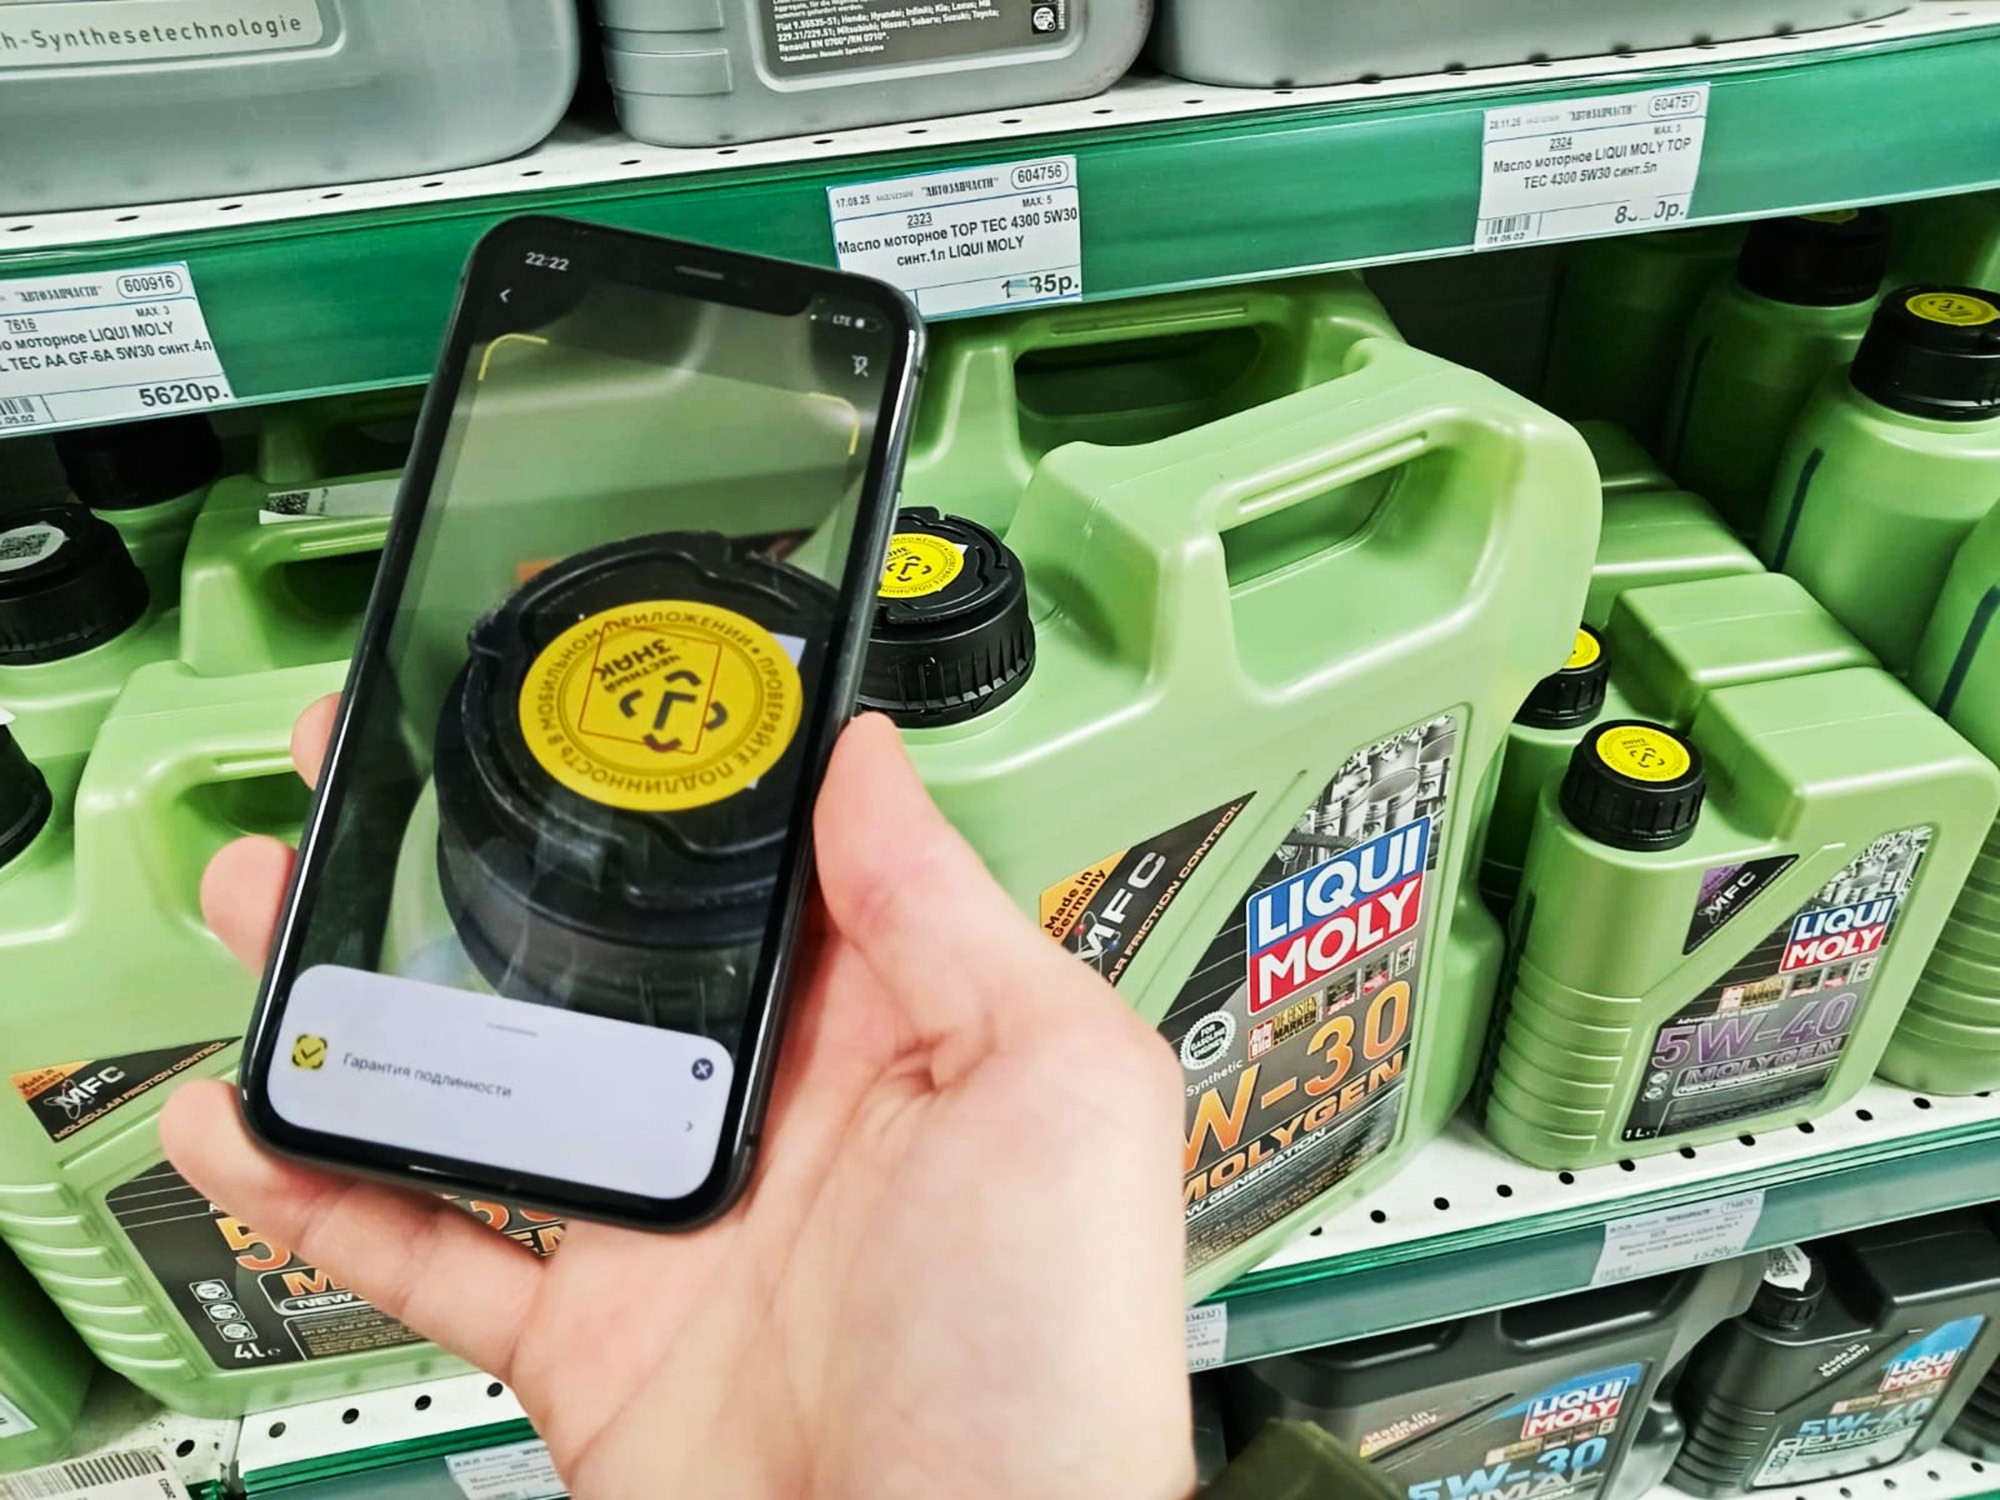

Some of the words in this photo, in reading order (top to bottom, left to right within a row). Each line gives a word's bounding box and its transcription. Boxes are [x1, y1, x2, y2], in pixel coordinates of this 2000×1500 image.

[0, 15, 302, 51] h-Synthesetechnologie
[1653, 95, 1695, 111] 604757
[1493, 160, 1532, 173] Масло
[1534, 152, 1592, 169] моторное
[1595, 146, 1627, 161] LIQUI
[1630, 140, 1666, 157] MOLY
[1667, 137, 1692, 151] TOP
[1550, 137, 1573, 150] 2324
[1017, 165, 1063, 184] 604756
[1524, 176, 1548, 189] TEC
[1550, 171, 1577, 185] 4300
[1579, 167, 1611, 182] 5W30
[1613, 162, 1658, 178] синт.5л
[837, 239, 882, 255] Масло
[884, 228, 948, 250] моторное
[950, 224, 979, 239] TOP
[981, 219, 1008, 234] TEC
[1010, 212, 1041, 229] 4300
[1043, 207, 1078, 225] 5W30
[907, 213, 933, 228] 2323
[525, 251, 570, 272] 22:22
[896, 249, 946, 267] синт.1л
[948, 241, 985, 260] LIQUI
[987, 234, 1025, 254] MOLY
[123, 275, 175, 294] 600916
[5, 318, 37, 333] 7616
[15, 332, 88, 350] моторное
[89, 326, 131, 343] LIQUI
[132, 320, 174, 339] MOLY
[831, 313, 851, 327] LTE
[9, 355, 42, 371] TEC
[45, 353, 67, 368] AA
[69, 349, 115, 366] GF-6A
[116, 344, 156, 361] 5W30
[158, 339, 212, 356] синт.4л
[138, 382, 230, 408] 5620р.
[605, 610, 753, 647] ПРИЛОЖЕНИИ
[590, 638, 673, 682] ЗНАК
[603, 654, 682, 694] ЧЕСТНЫЙ
[537, 627, 603, 732] МОБИЛЬНОМ
[737, 656, 785, 767] ПРОВЕРЯЙТЕ
[561, 747, 736, 795] ПОДЛИННОСТЬ
[1126, 879, 1181, 957] FRICTION
[1178, 801, 1243, 879] CONTROL
[1257, 825, 1422, 941] LIQUI
[1704, 871, 1756, 916] MFC
[1044, 887, 1080, 931] Made
[1075, 870, 1093, 888] in
[1051, 868, 1107, 938] Germany
[1074, 851, 1167, 962] MFC
[1795, 898, 1894, 941] LIQUI
[1258, 879, 1418, 1005] MOLY
[1787, 926, 1884, 970] MOLY
[1274, 1010, 1317, 1040] MARKEN
[1651, 992, 1858, 1069] 5W-40
[343, 1052, 411, 1078] Гарантия
[414, 1069, 512, 1099] подлинности
[1186, 1060, 1244, 1097] Synthetic
[1685, 1037, 1842, 1085] MOLYGEN
[54, 1097, 124, 1140] MOLECULAR
[123, 1069, 174, 1100] FRICTION
[172, 1041, 227, 1072] CONTROL
[58, 1066, 126, 1108] MFC
[1183, 1051, 1404, 1205] MOLYGEN
[1208, 1127, 1328, 1205] GENERATION
[297, 1293, 354, 1308] NEW
[1819, 1352, 1849, 1371] Made
[1846, 1343, 1861, 1353] in
[1822, 1344, 1871, 1378] Germany
[1892, 1348, 1959, 1375] LIQUI
[1885, 1363, 1952, 1391] MOLY
[1531, 1379, 1622, 1417] LIQUI
[1528, 1399, 1619, 1437] MOLY
[1776, 1420, 1923, 1450] OPTIMAL
[1798, 1397, 1934, 1438] 5W-40
[1408, 1437, 1608, 1500] 5W-30
